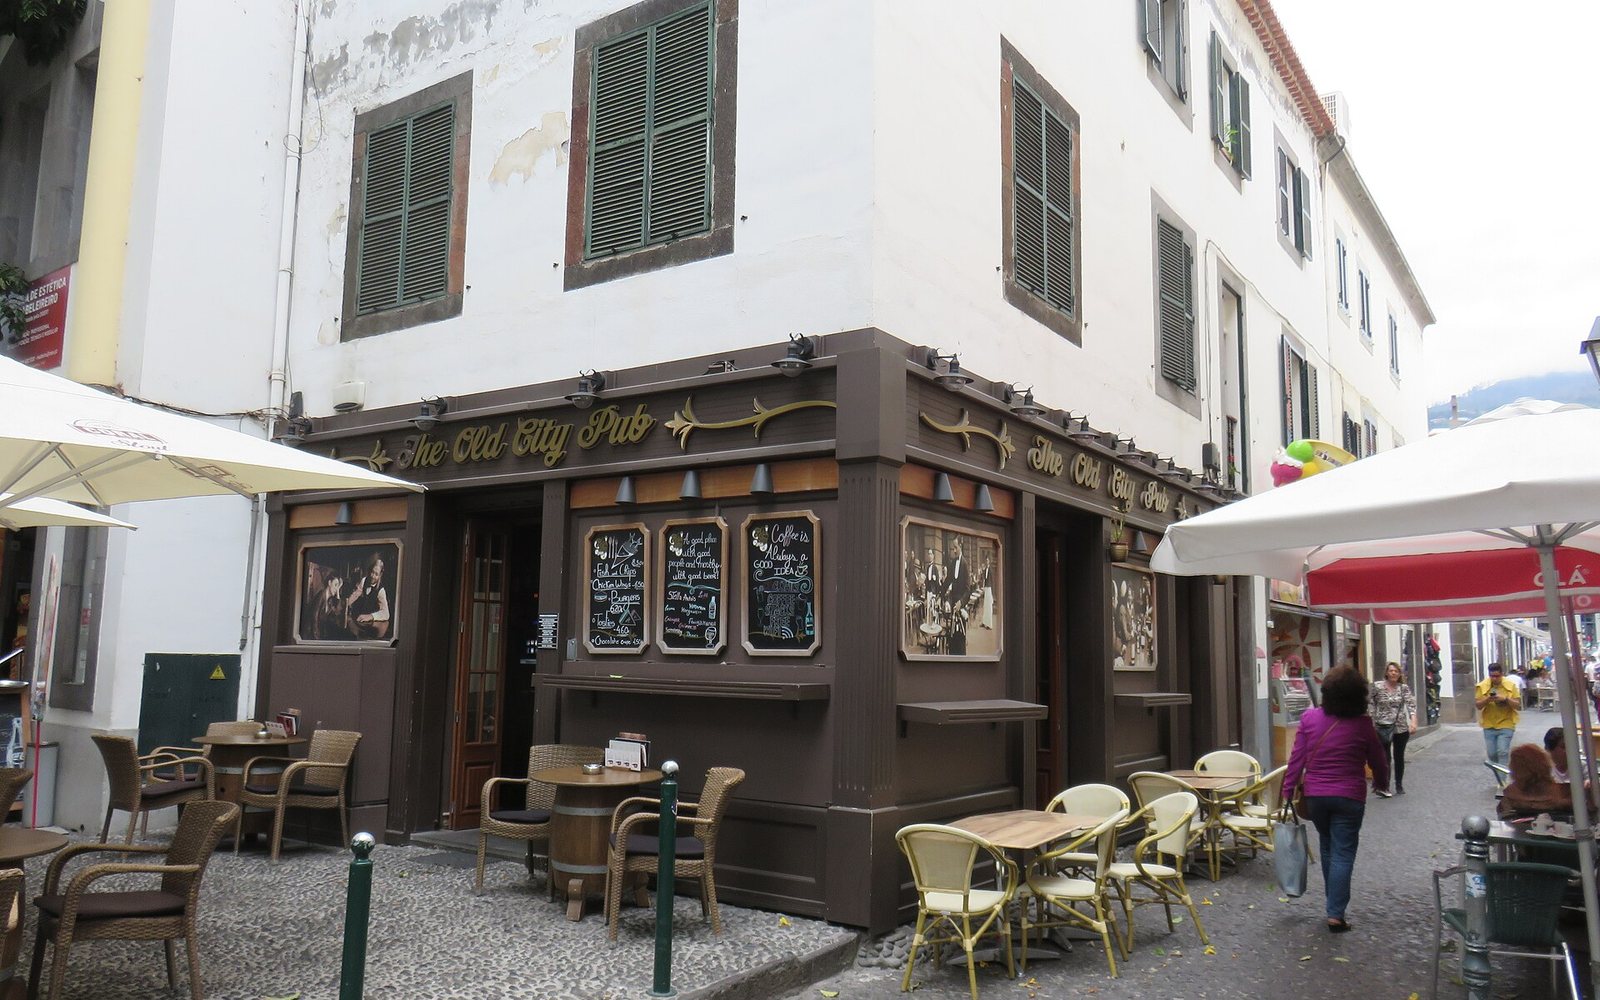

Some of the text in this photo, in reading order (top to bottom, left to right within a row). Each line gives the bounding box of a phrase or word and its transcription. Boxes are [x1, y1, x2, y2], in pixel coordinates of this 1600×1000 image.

[31, 287, 39, 300] DE
[396, 403, 656, 470] The Old City Pub
[1027, 434, 1170, 513] The Old City Pub
[691, 531, 704, 548] good
[771, 523, 799, 547] Coffee
[800, 530, 810, 543] is
[696, 546, 711, 563] good
[764, 543, 809, 568] Always a
[597, 562, 610, 577] Fish
[619, 563, 637, 581] Chips
[668, 558, 685, 573] people
[685, 559, 696, 568] and
[753, 560, 773, 569] GOOD
[774, 567, 794, 576] IDEA
[592, 578, 614, 591] Chicken
[615, 579, 631, 589] Wings
[672, 569, 686, 580] with
[688, 570, 702, 584] good
